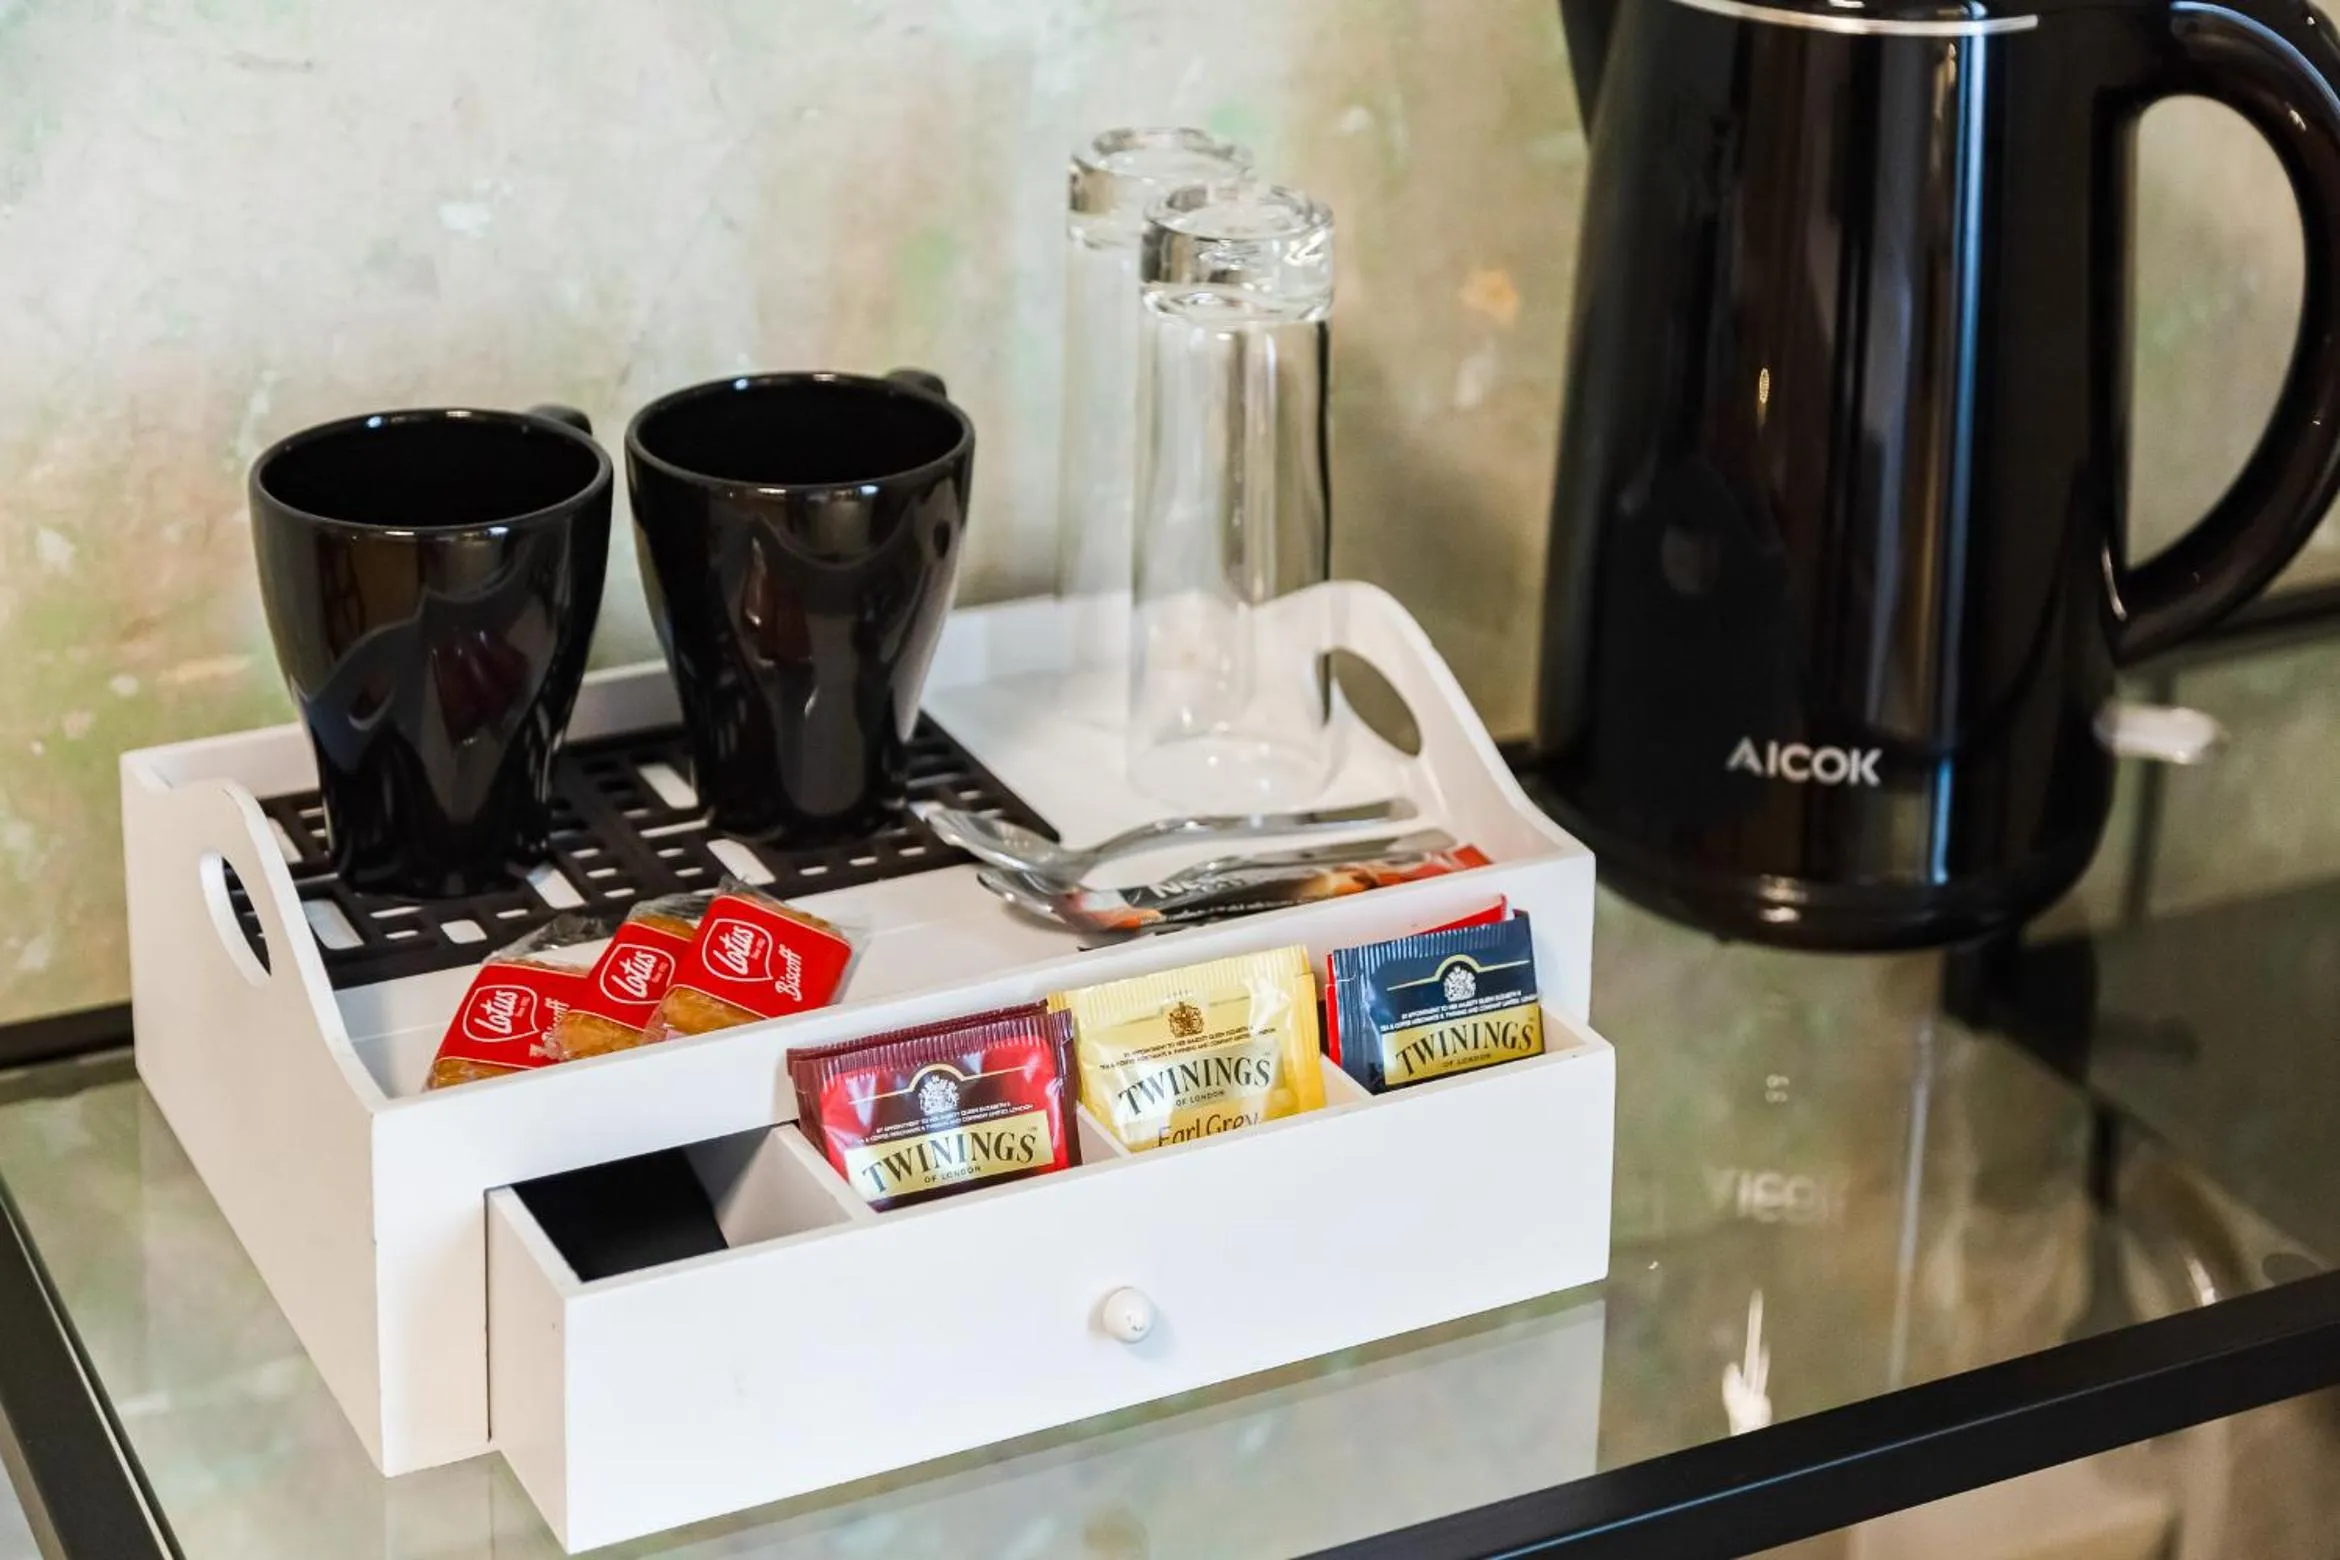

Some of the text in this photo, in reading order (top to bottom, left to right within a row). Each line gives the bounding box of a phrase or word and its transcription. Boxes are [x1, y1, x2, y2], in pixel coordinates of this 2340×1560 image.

[1725, 736, 1883, 787] AICOK
[611, 951, 657, 998] Lotus
[712, 925, 755, 976] Lotus
[775, 943, 802, 1002] Biscoff
[474, 990, 518, 1034] Lotus
[1396, 1020, 1534, 1077] TWININGS
[1118, 1057, 1271, 1116] TWININGS
[1176, 1090, 1225, 1107] OF LONDON
[1158, 1118, 1201, 1147] Earl
[861, 1129, 1036, 1193] TWININGS
[924, 1165, 981, 1184] OF LONDON
